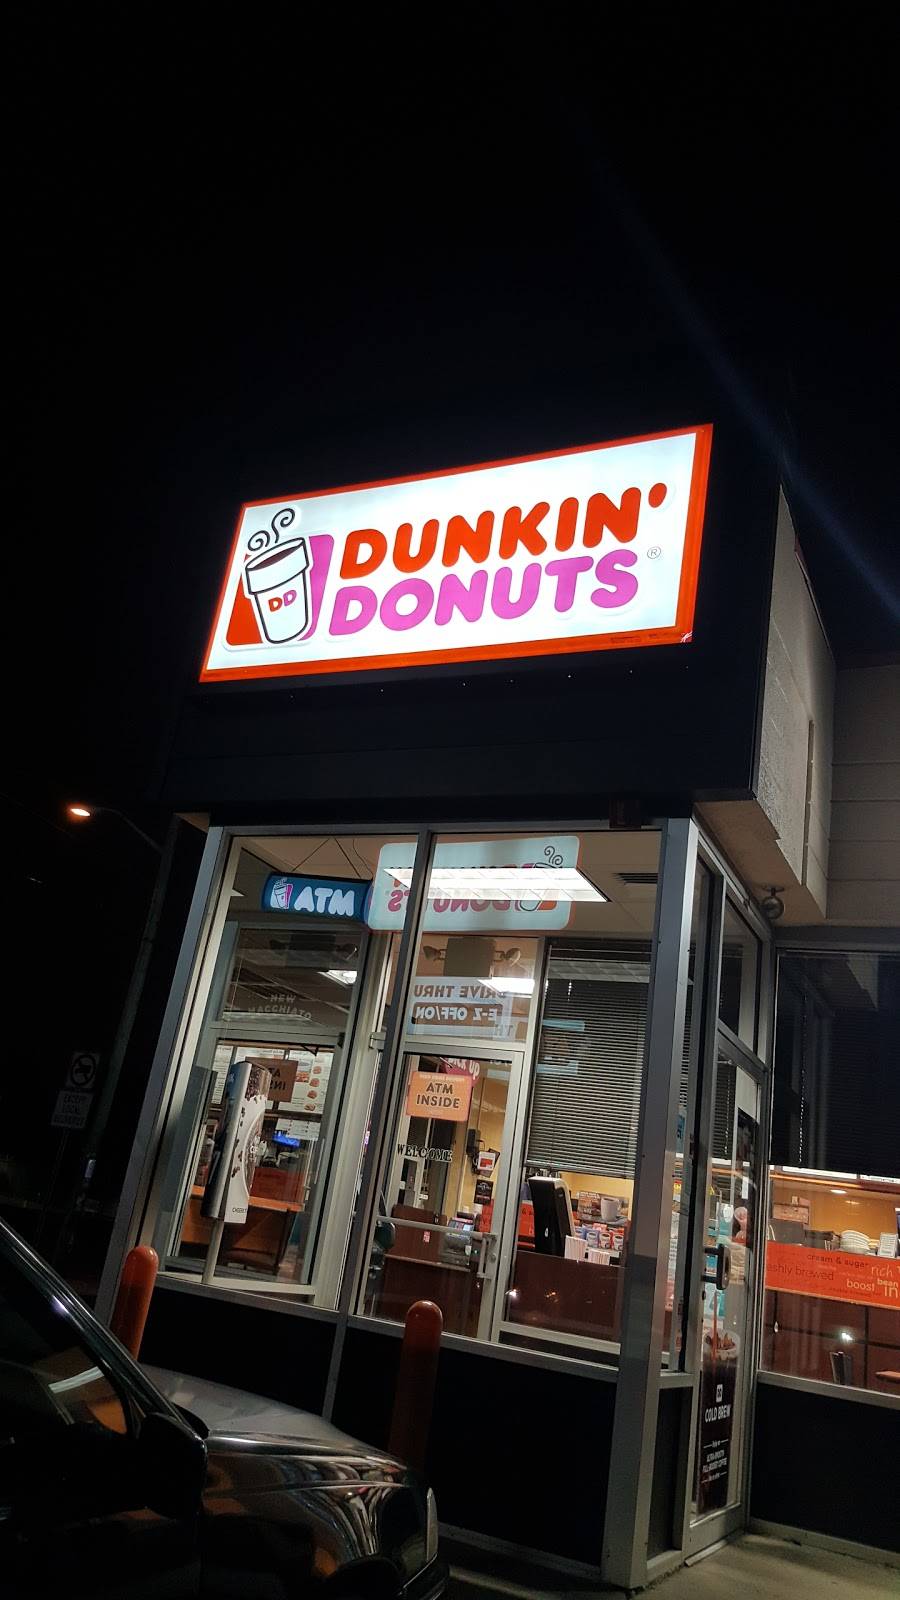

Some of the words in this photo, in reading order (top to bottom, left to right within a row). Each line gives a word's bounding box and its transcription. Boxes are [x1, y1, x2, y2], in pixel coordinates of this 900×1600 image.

[340, 482, 667, 580] DUNKIN'
[268, 589, 297, 612] DD
[329, 549, 638, 636] DONUTS
[293, 886, 354, 916] ATM
[270, 993, 297, 1003] NEW
[426, 1082, 453, 1095] ATM
[416, 1094, 460, 1109] INSIDE
[397, 1144, 453, 1163] WELCOME
[795, 1265, 834, 1281] brewed
[704, 1406, 718, 1423] COLD
[717, 1403, 731, 1420] BREW
